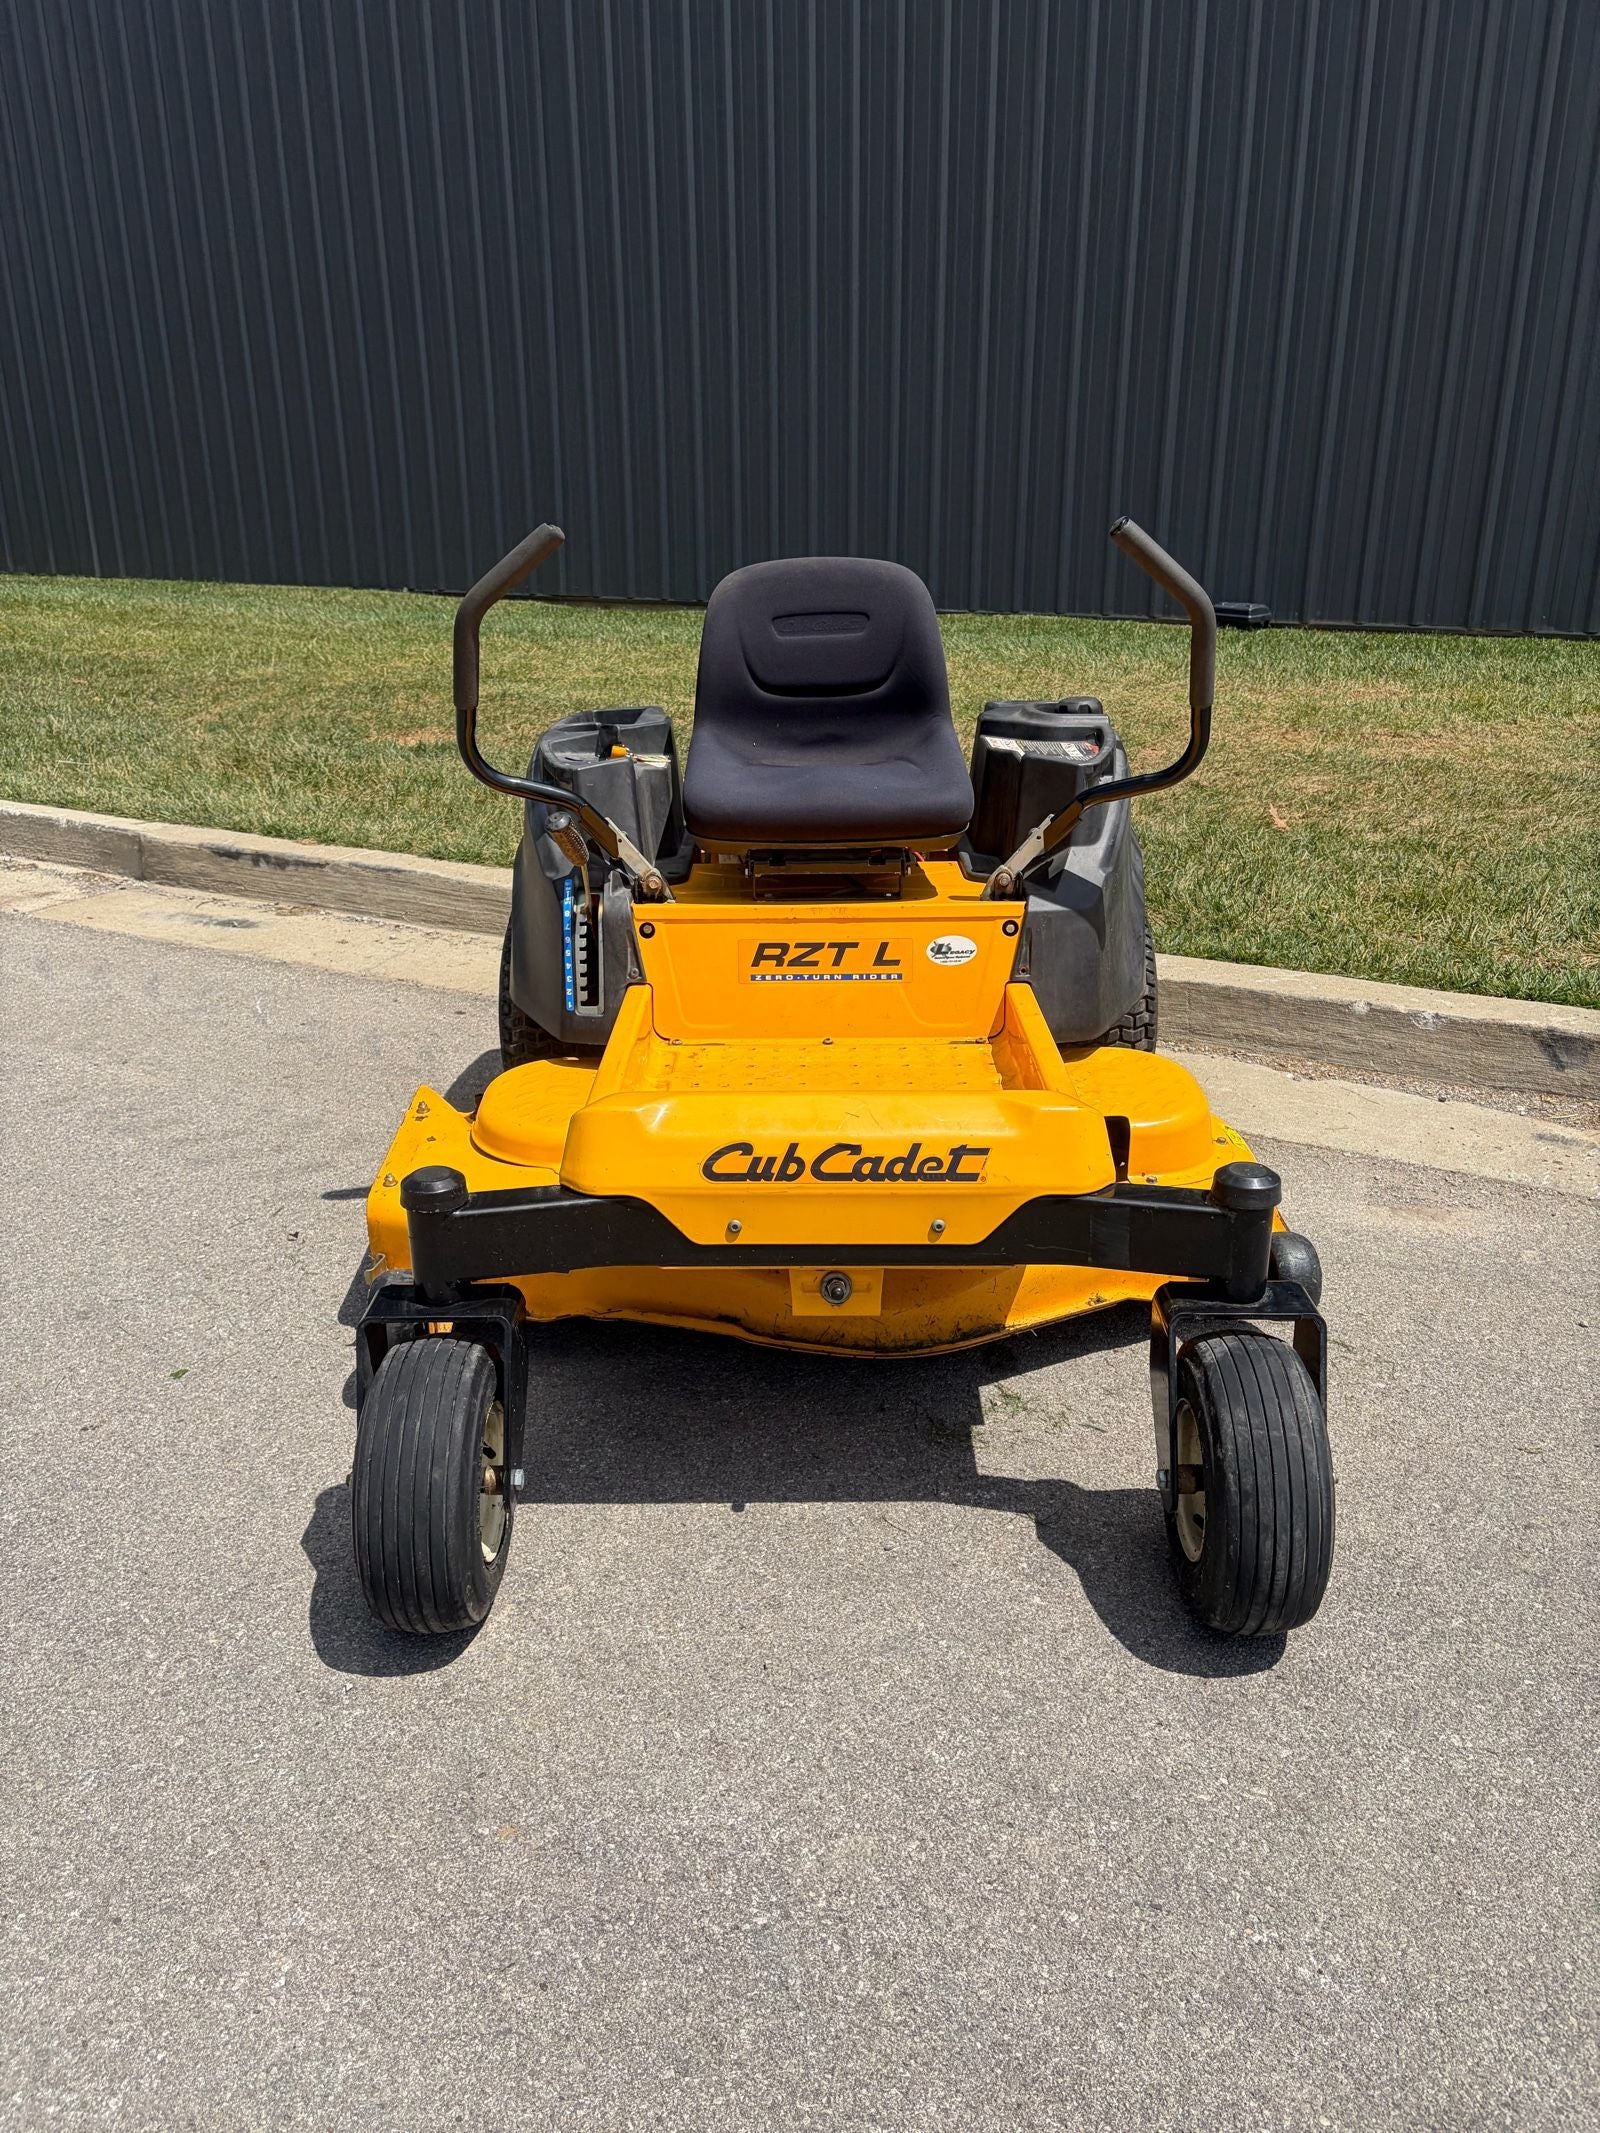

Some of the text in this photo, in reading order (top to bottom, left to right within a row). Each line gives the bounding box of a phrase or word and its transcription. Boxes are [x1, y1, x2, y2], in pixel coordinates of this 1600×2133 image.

[751, 942, 901, 967] RZT L
[702, 1142, 991, 1182] Cub Cadet
